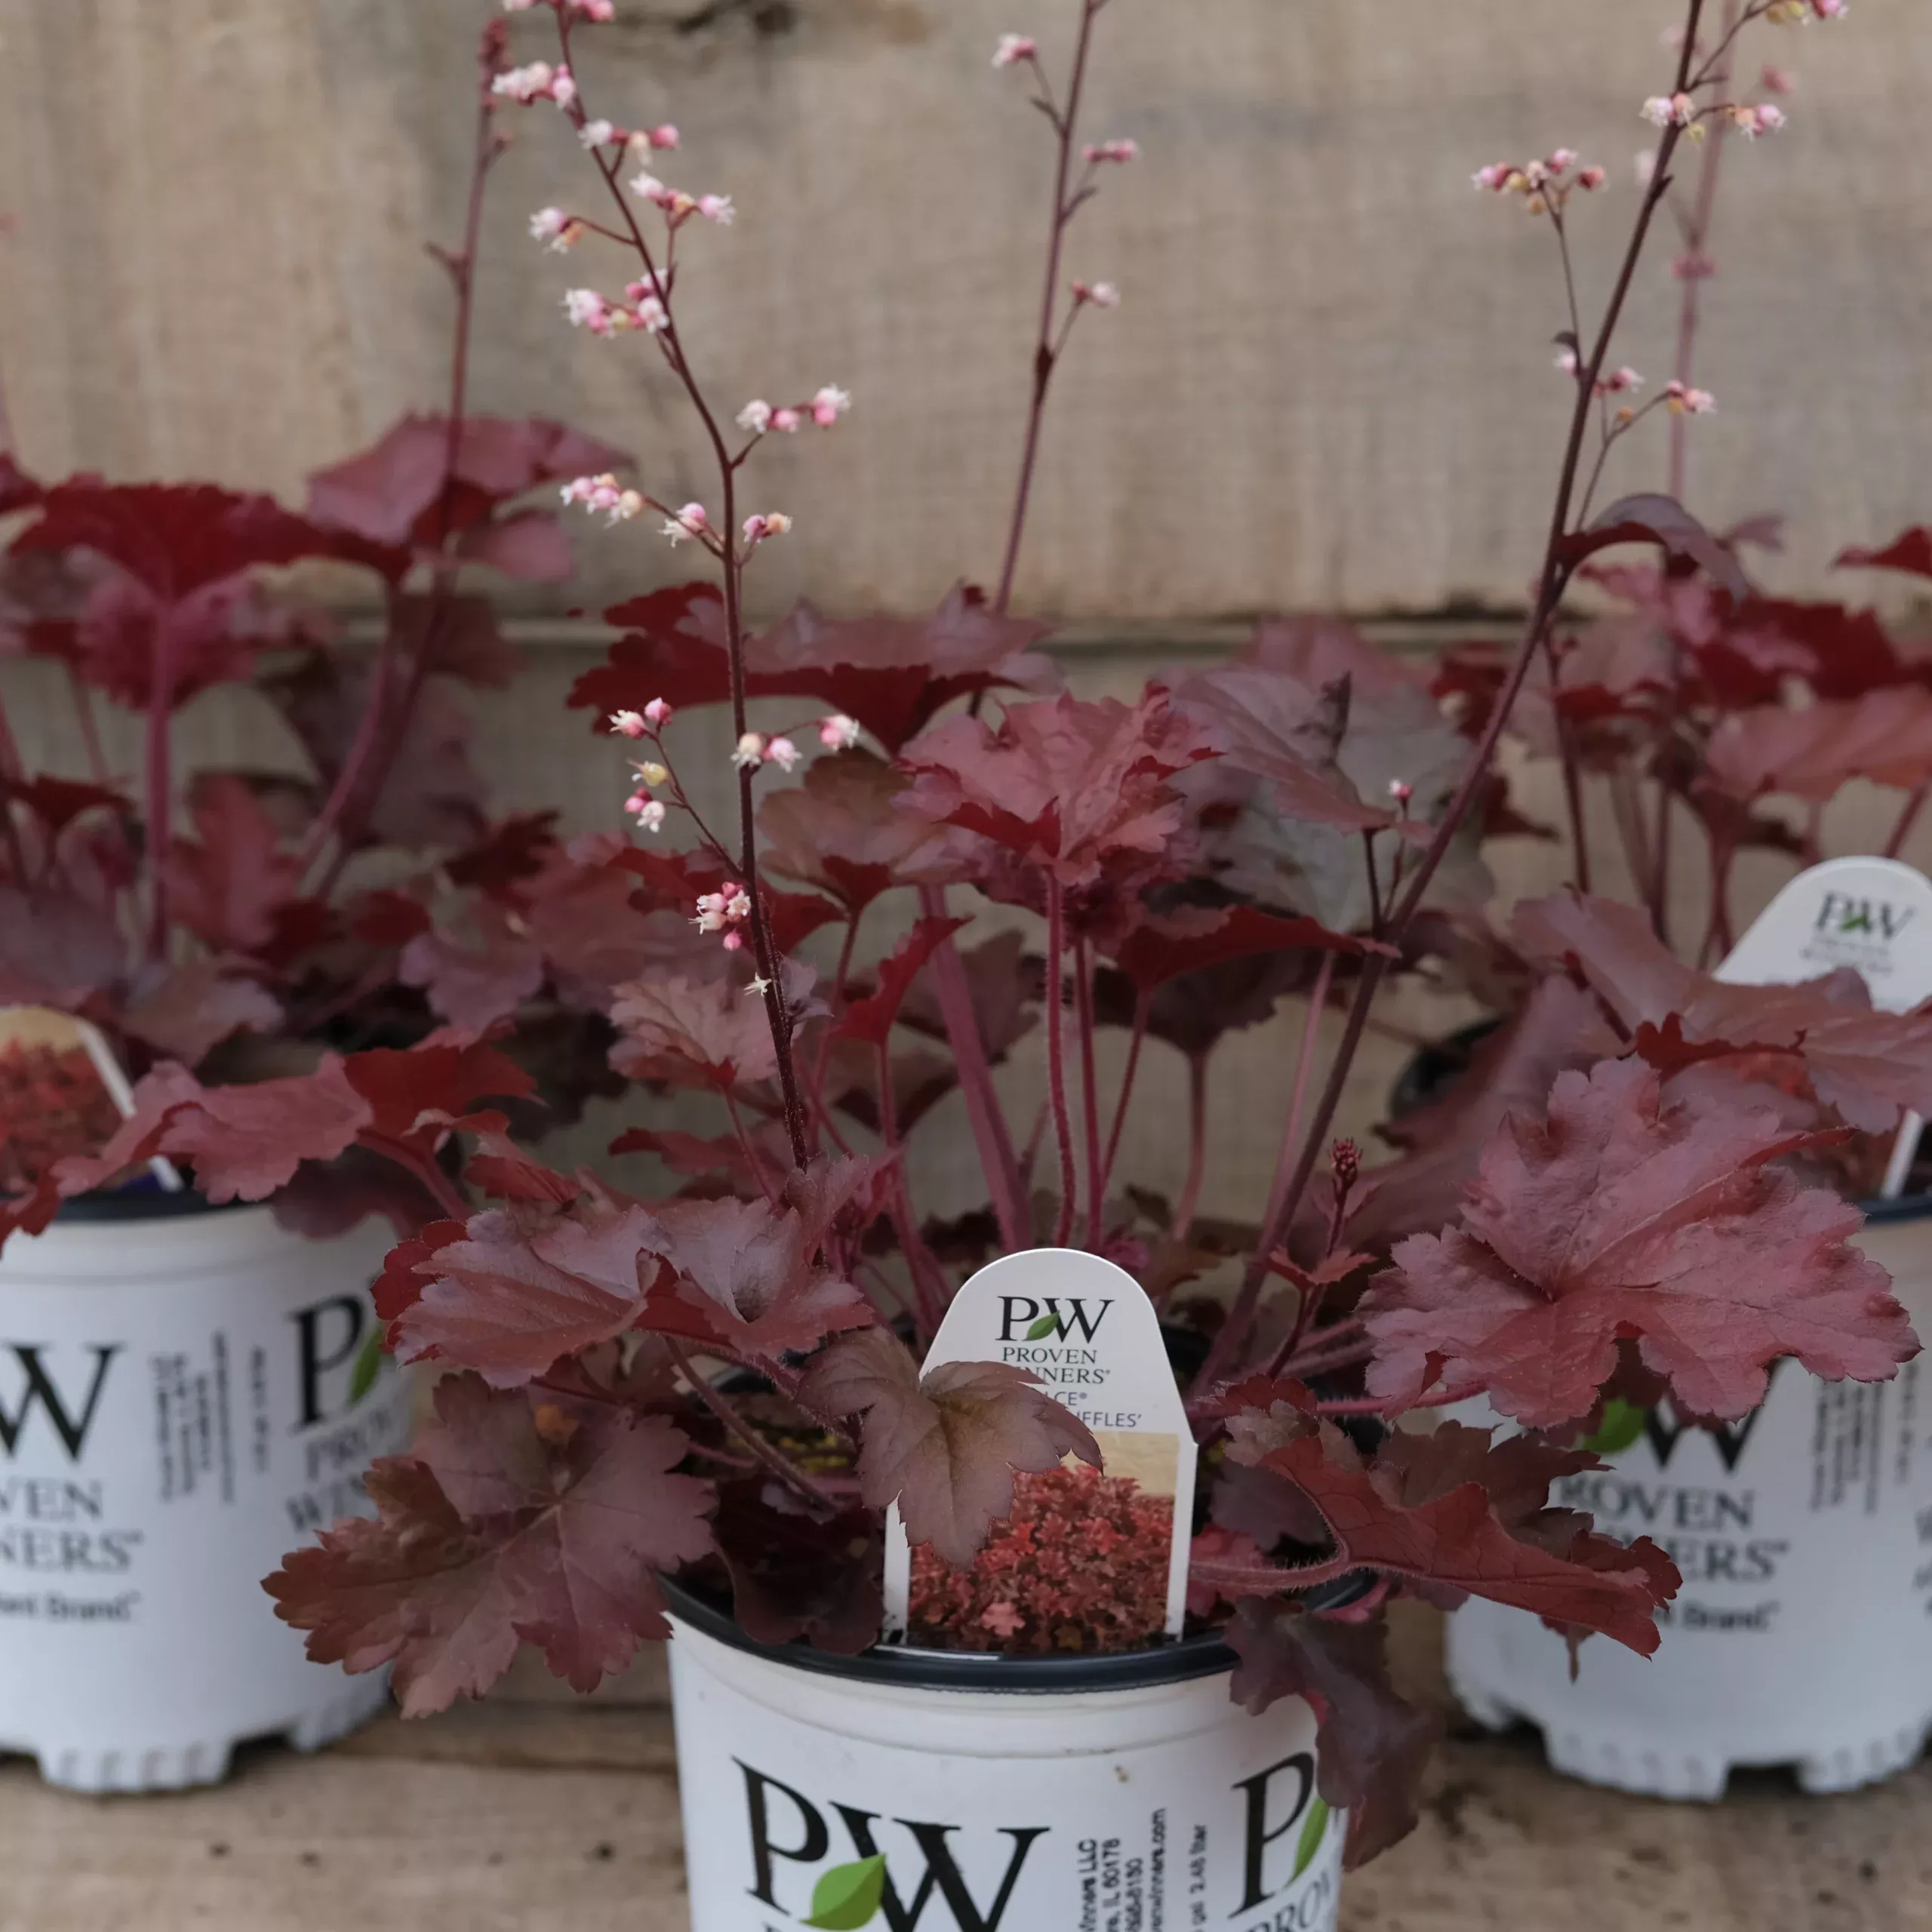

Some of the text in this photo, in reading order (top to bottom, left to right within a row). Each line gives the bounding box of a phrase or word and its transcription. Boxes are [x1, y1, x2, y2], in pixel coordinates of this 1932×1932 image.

[995, 1295, 1115, 1344] PW
[287, 1295, 364, 1430] P
[1002, 1346, 1097, 1364] PROVEN
[1558, 1475, 1755, 1530] ROVEN
[1077, 1838, 1097, 1873] LLC
